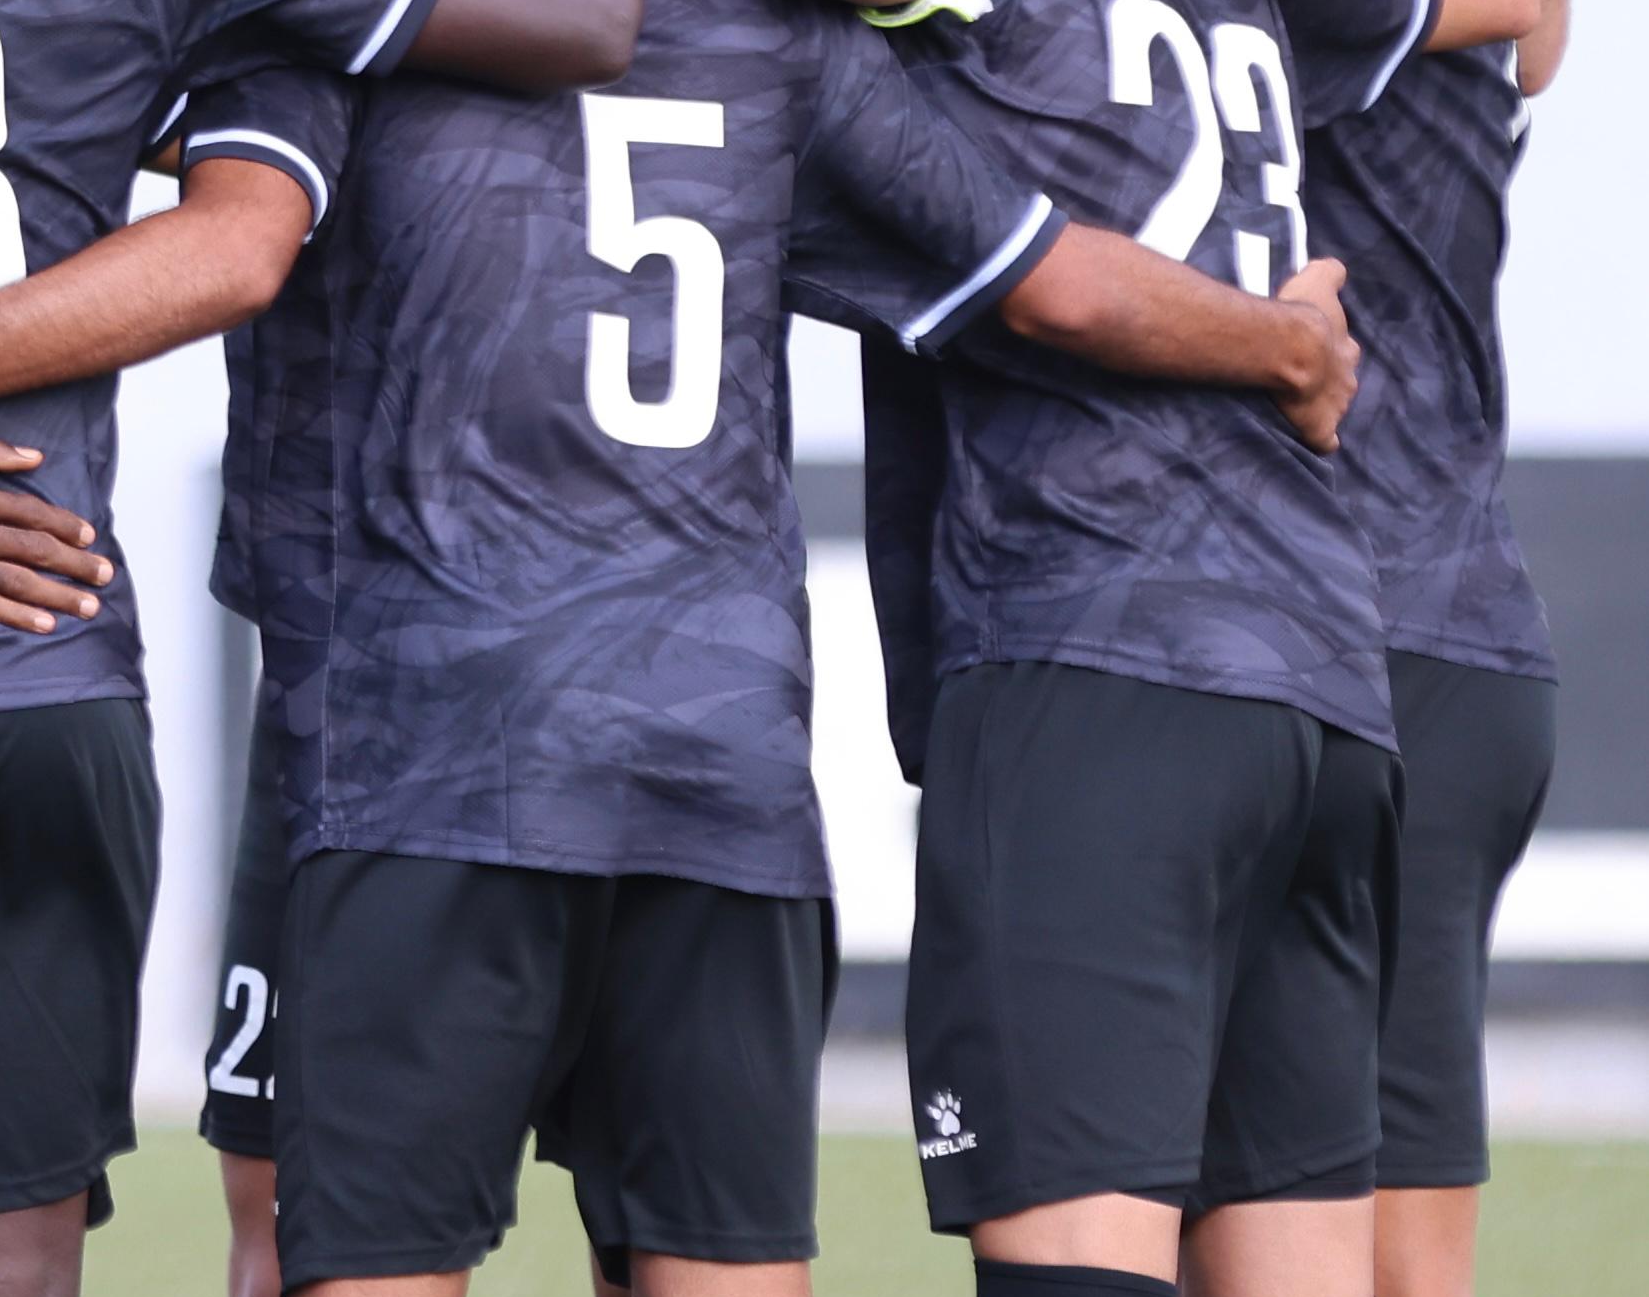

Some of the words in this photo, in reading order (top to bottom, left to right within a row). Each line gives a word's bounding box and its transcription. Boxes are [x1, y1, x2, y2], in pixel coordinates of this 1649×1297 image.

[582, 93, 725, 449] 5
[209, 963, 278, 1100] 2
[920, 1133, 978, 1160] KELME
